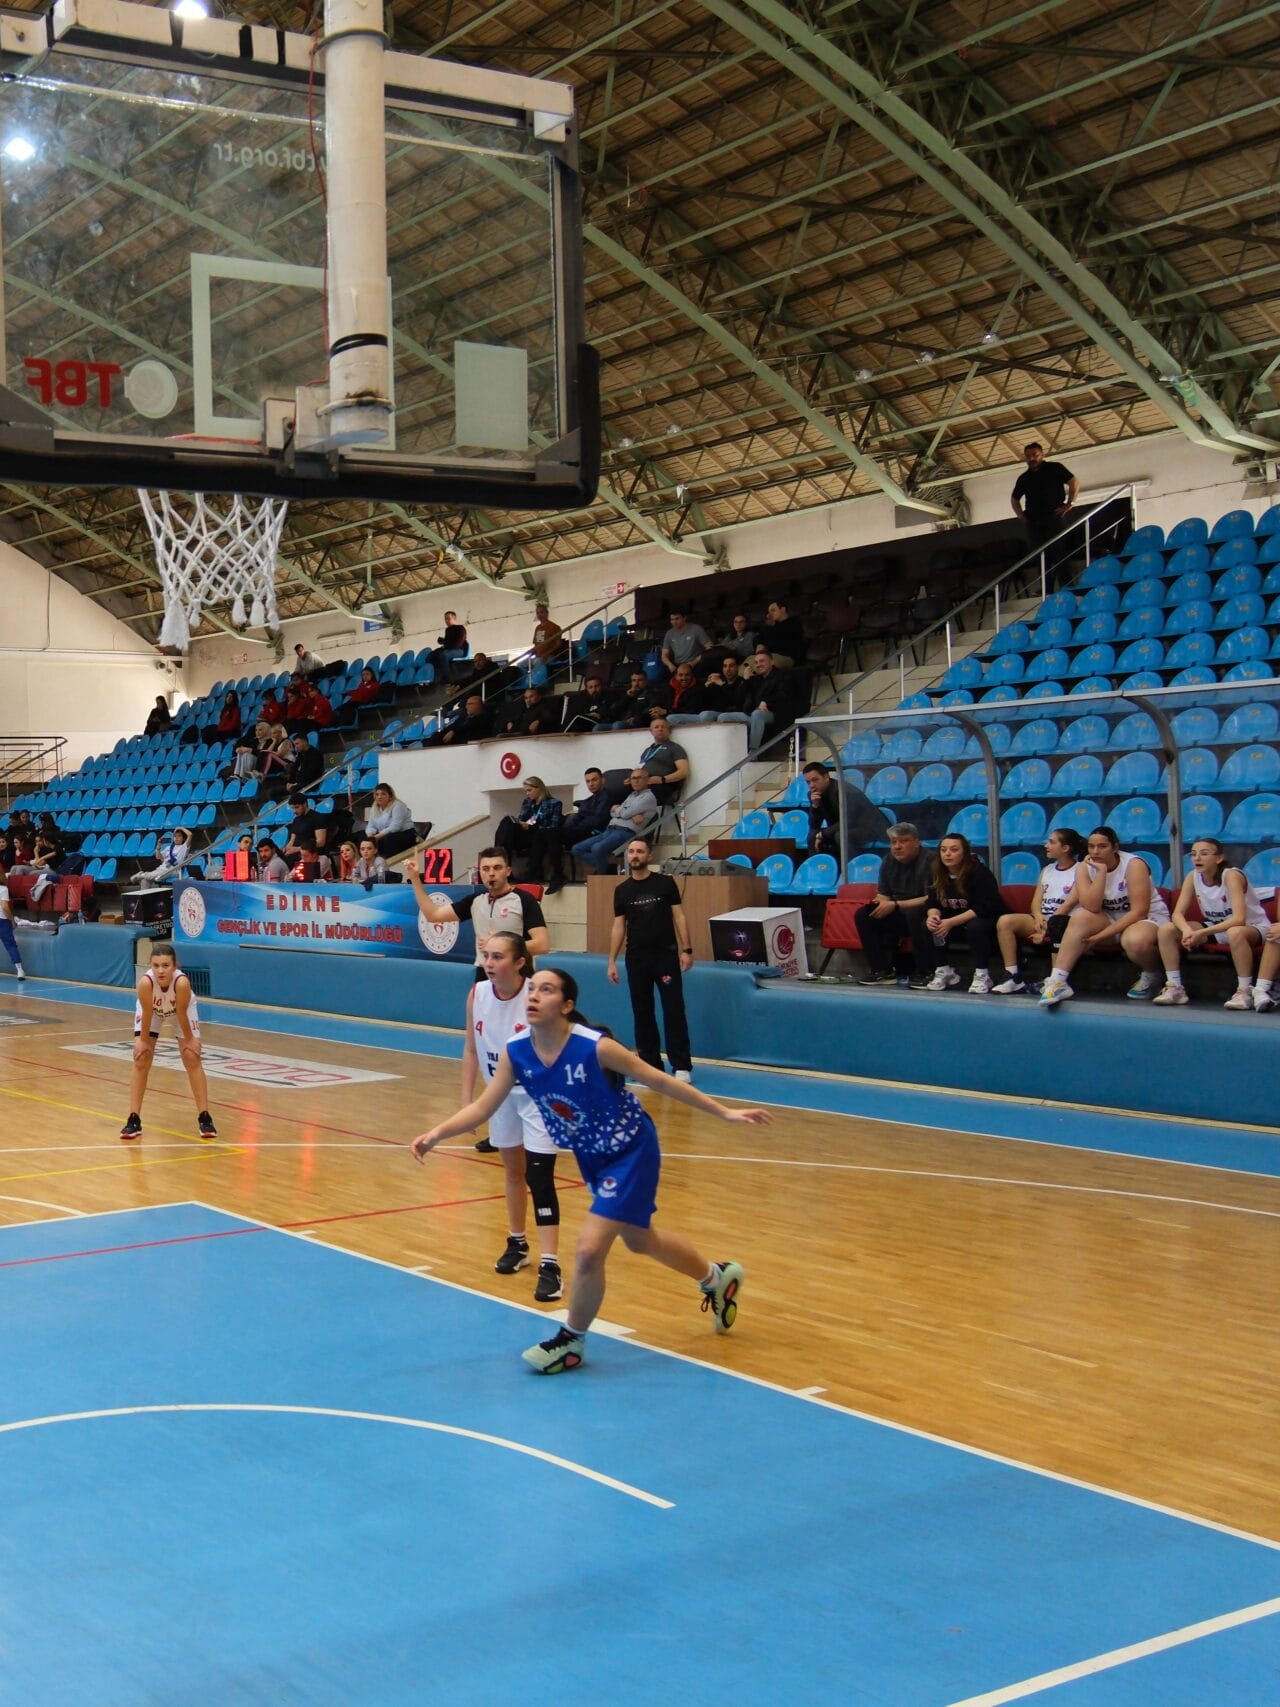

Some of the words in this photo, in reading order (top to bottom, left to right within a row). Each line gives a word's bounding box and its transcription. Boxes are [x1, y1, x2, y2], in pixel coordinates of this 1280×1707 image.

[425, 848, 451, 883] 22
[266, 892, 340, 913] EDİRNE
[263, 922, 277, 936] VE
[280, 922, 309, 937] SPOR
[311, 920, 323, 938] İL
[325, 922, 403, 943] MÜDÜRLÜĞÜ
[476, 1020, 484, 1036] 4
[565, 1063, 587, 1085] 14
